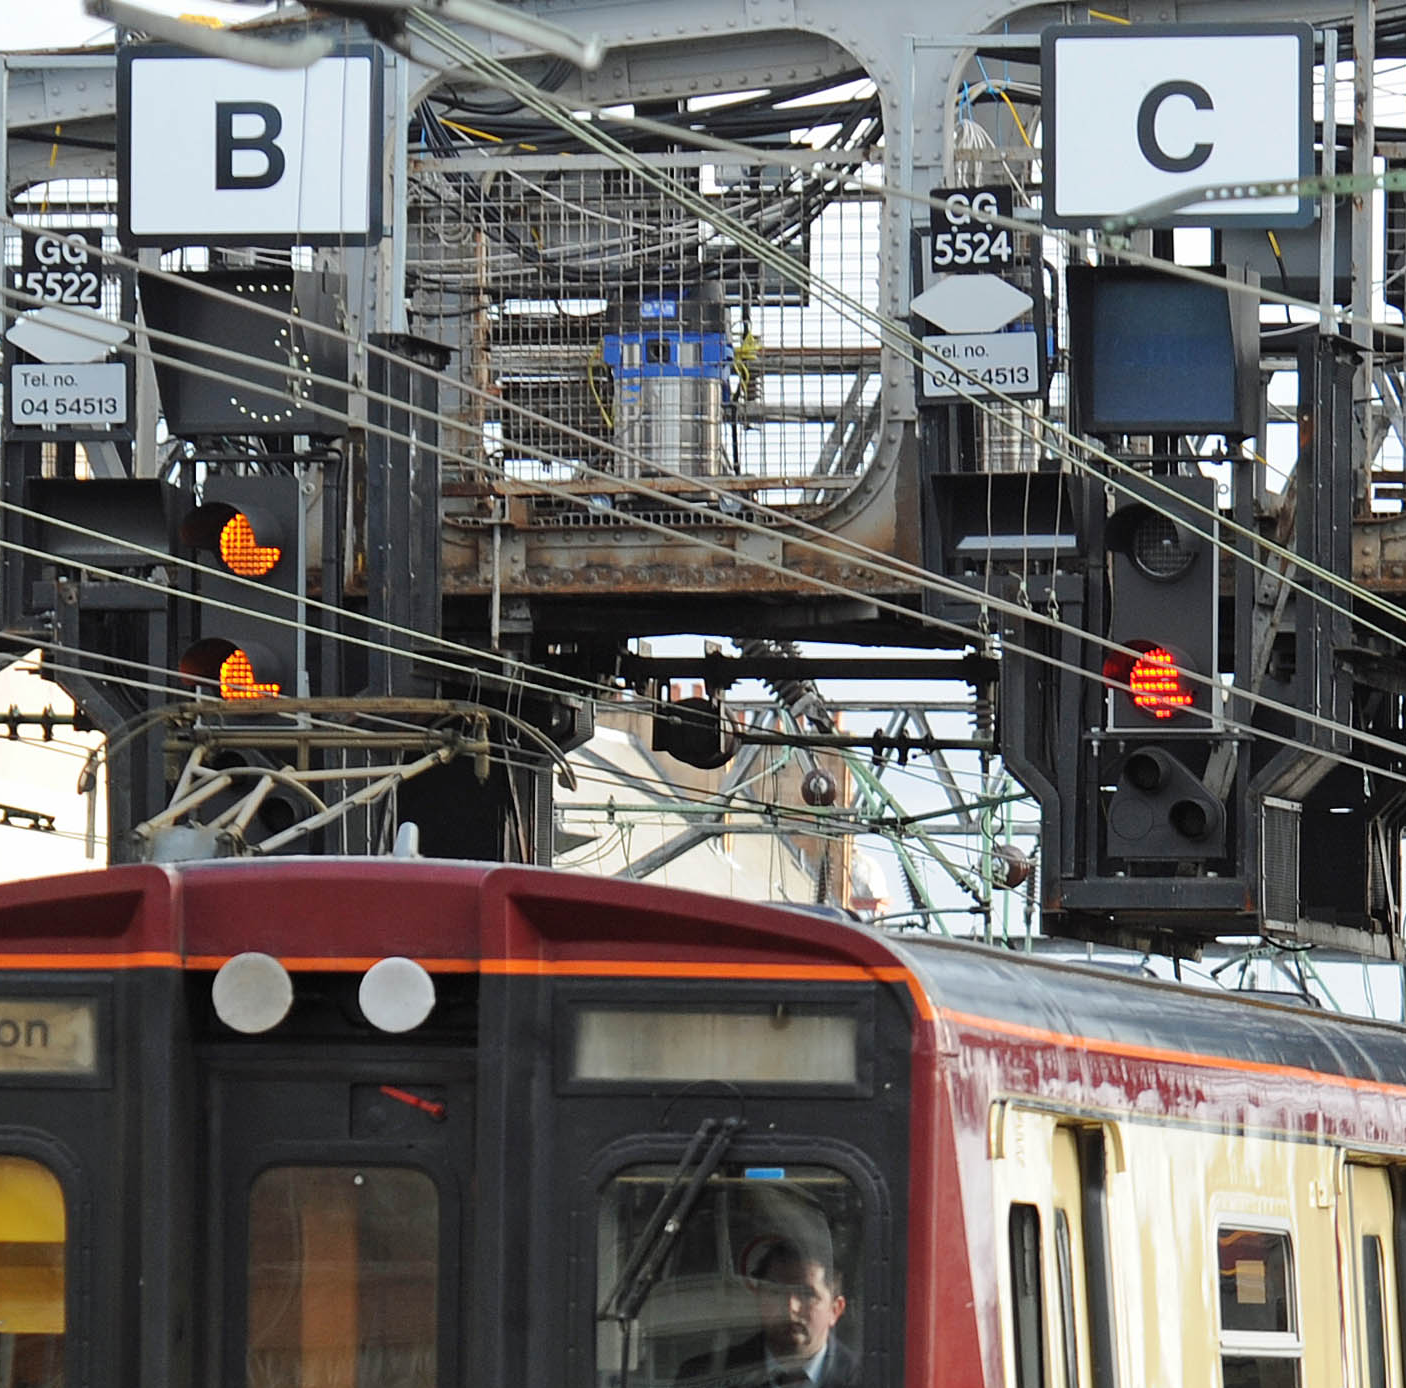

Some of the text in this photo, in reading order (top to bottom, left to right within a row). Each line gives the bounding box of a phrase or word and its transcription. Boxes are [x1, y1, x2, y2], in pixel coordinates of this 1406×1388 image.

[1137, 79, 1215, 173] C
[215, 101, 286, 190] B
[945, 192, 998, 225] GG
[35, 233, 88, 265] GG
[934, 231, 1012, 265] 5524
[26, 272, 98, 303] 5522
[931, 343, 989, 359] Tel. no.
[21, 373, 79, 387] Tel. no.
[932, 366, 1030, 388] 04 54513
[21, 397, 118, 415] 04 54513
